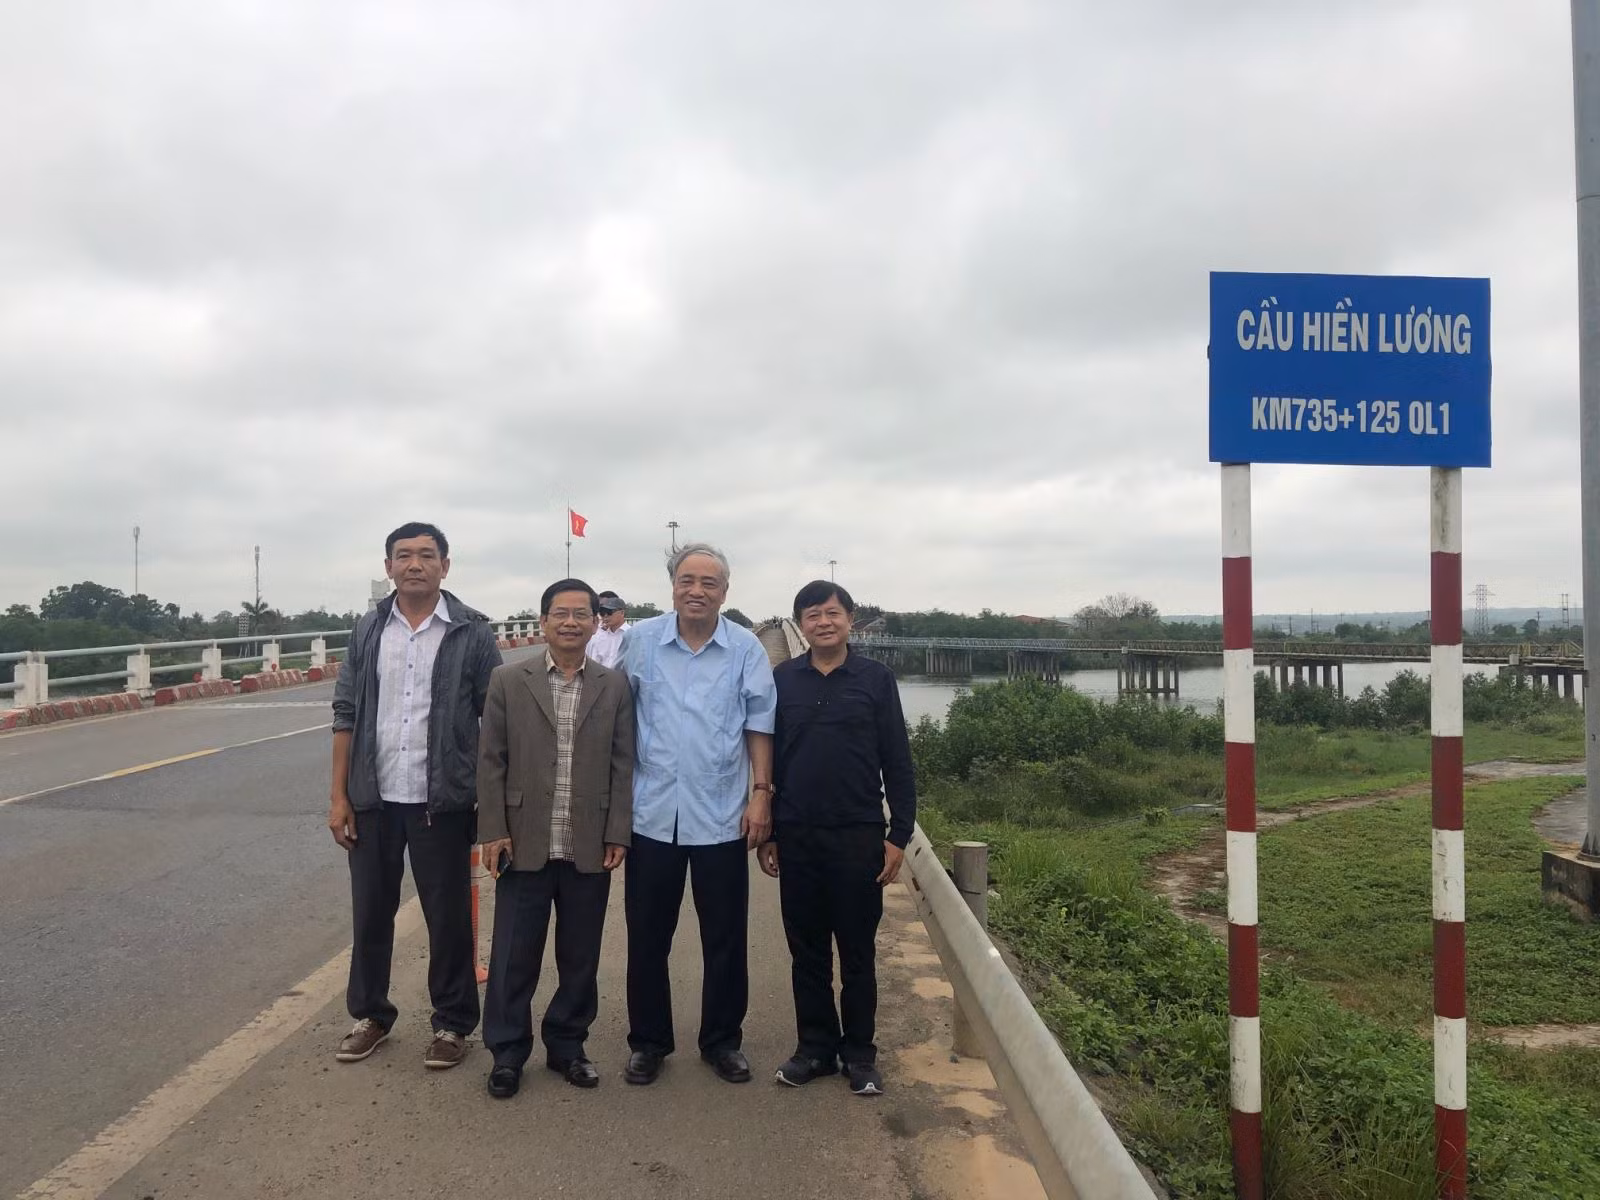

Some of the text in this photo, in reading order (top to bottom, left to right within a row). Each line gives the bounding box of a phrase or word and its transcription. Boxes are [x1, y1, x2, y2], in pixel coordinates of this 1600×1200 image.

[1237, 296, 1472, 354] CẦU HIỀN LƯƠNG
[1252, 397, 1400, 434] KM735+125
